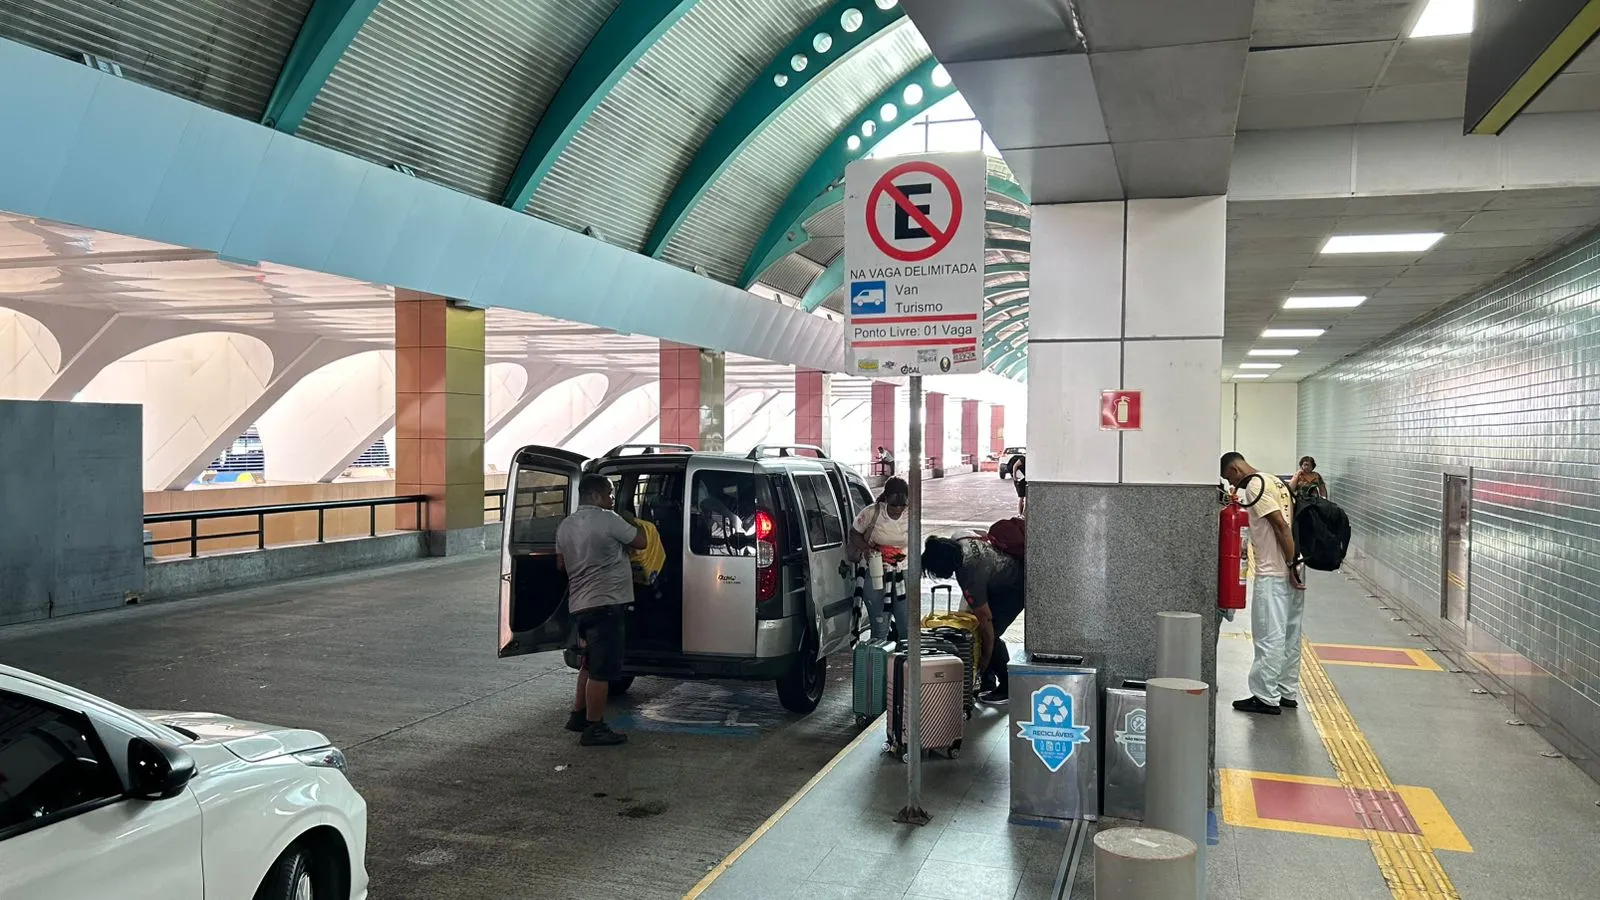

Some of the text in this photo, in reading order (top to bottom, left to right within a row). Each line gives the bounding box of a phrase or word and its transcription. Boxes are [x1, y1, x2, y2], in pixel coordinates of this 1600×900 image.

[894, 183, 932, 240] E
[850, 263, 977, 279] NA VAGA DELIMITADA
[895, 284, 919, 295] Van
[895, 301, 943, 313] Turismo
[854, 324, 972, 338] Ponto Livre: 01 Vaga
[1032, 729, 1074, 738] RECICLÁVEIS
